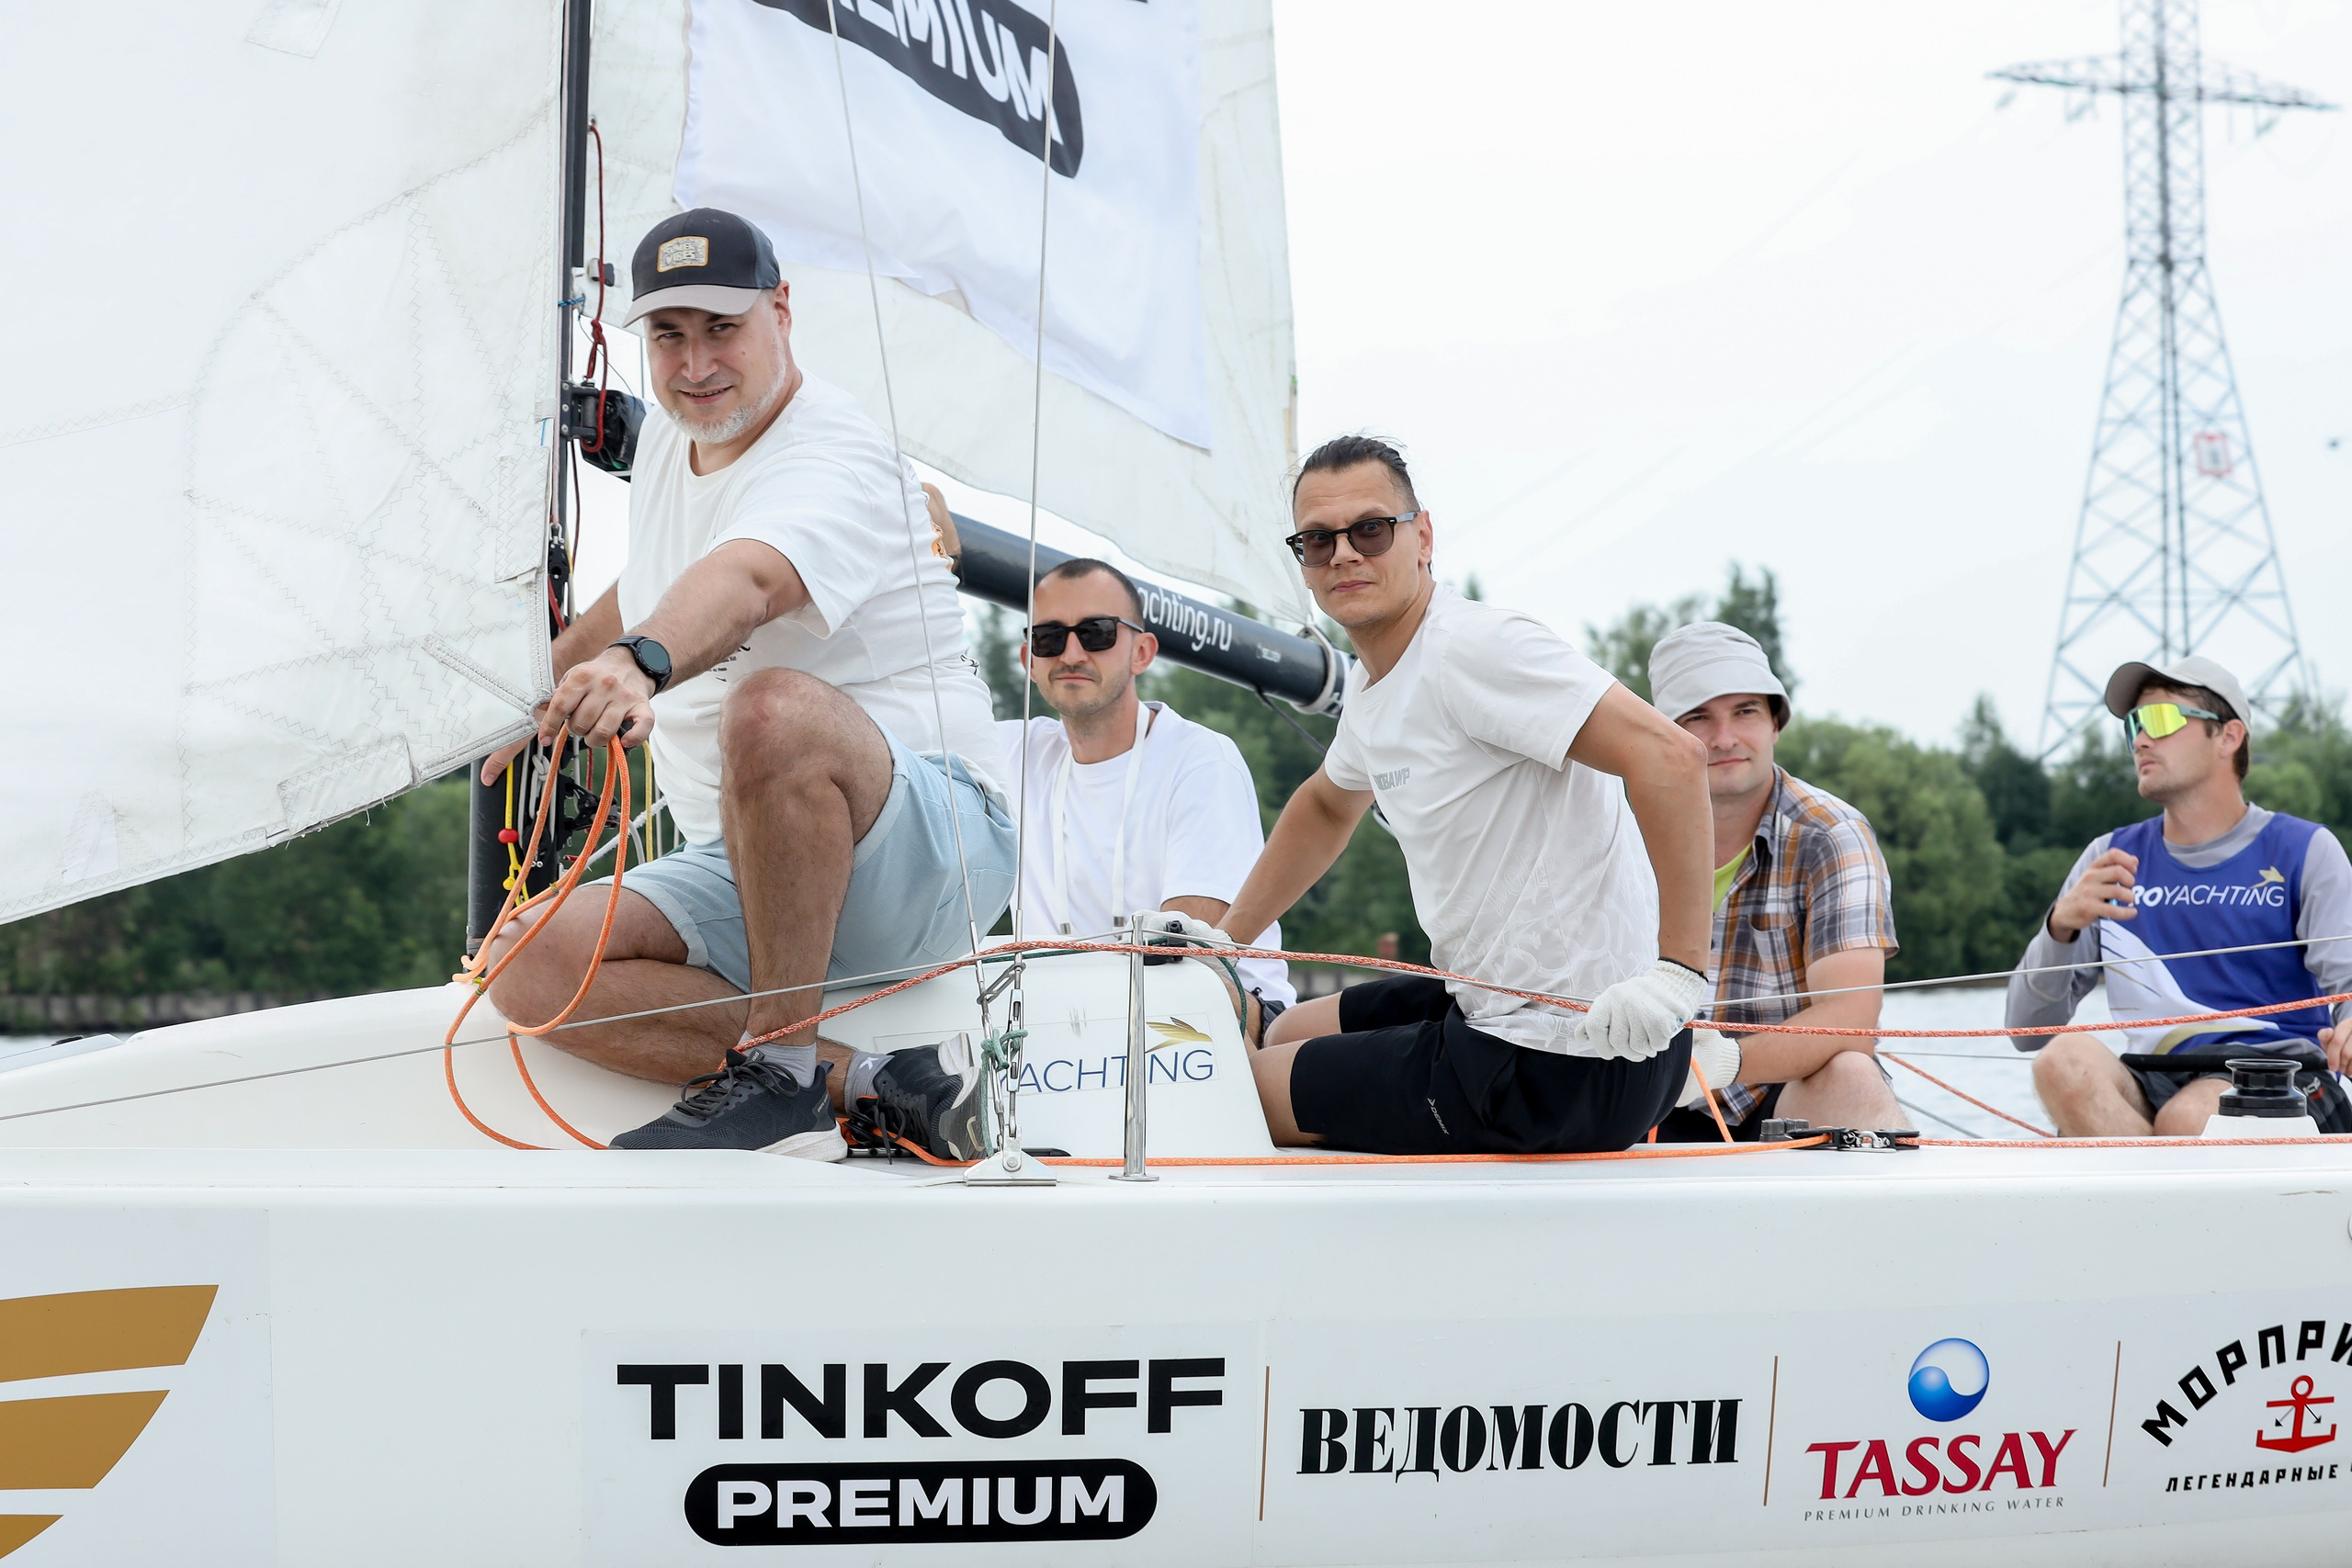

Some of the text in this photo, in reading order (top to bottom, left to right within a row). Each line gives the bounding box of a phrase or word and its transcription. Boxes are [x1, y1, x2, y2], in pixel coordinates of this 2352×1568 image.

[2128, 884, 2285, 908] ROYACHTING
[616, 1357, 1226, 1440] TINKOFF
[1295, 1398, 1744, 1483] ВЕДОМОСТИ
[1804, 1428, 2078, 1500] TASSAY
[717, 1474, 1125, 1529] PREMIUM
[2165, 1463, 2339, 1493] ЛЕГЕНДАРНЫЕ
[1804, 1496, 2064, 1521] PREMIUM DRINKING WATER
